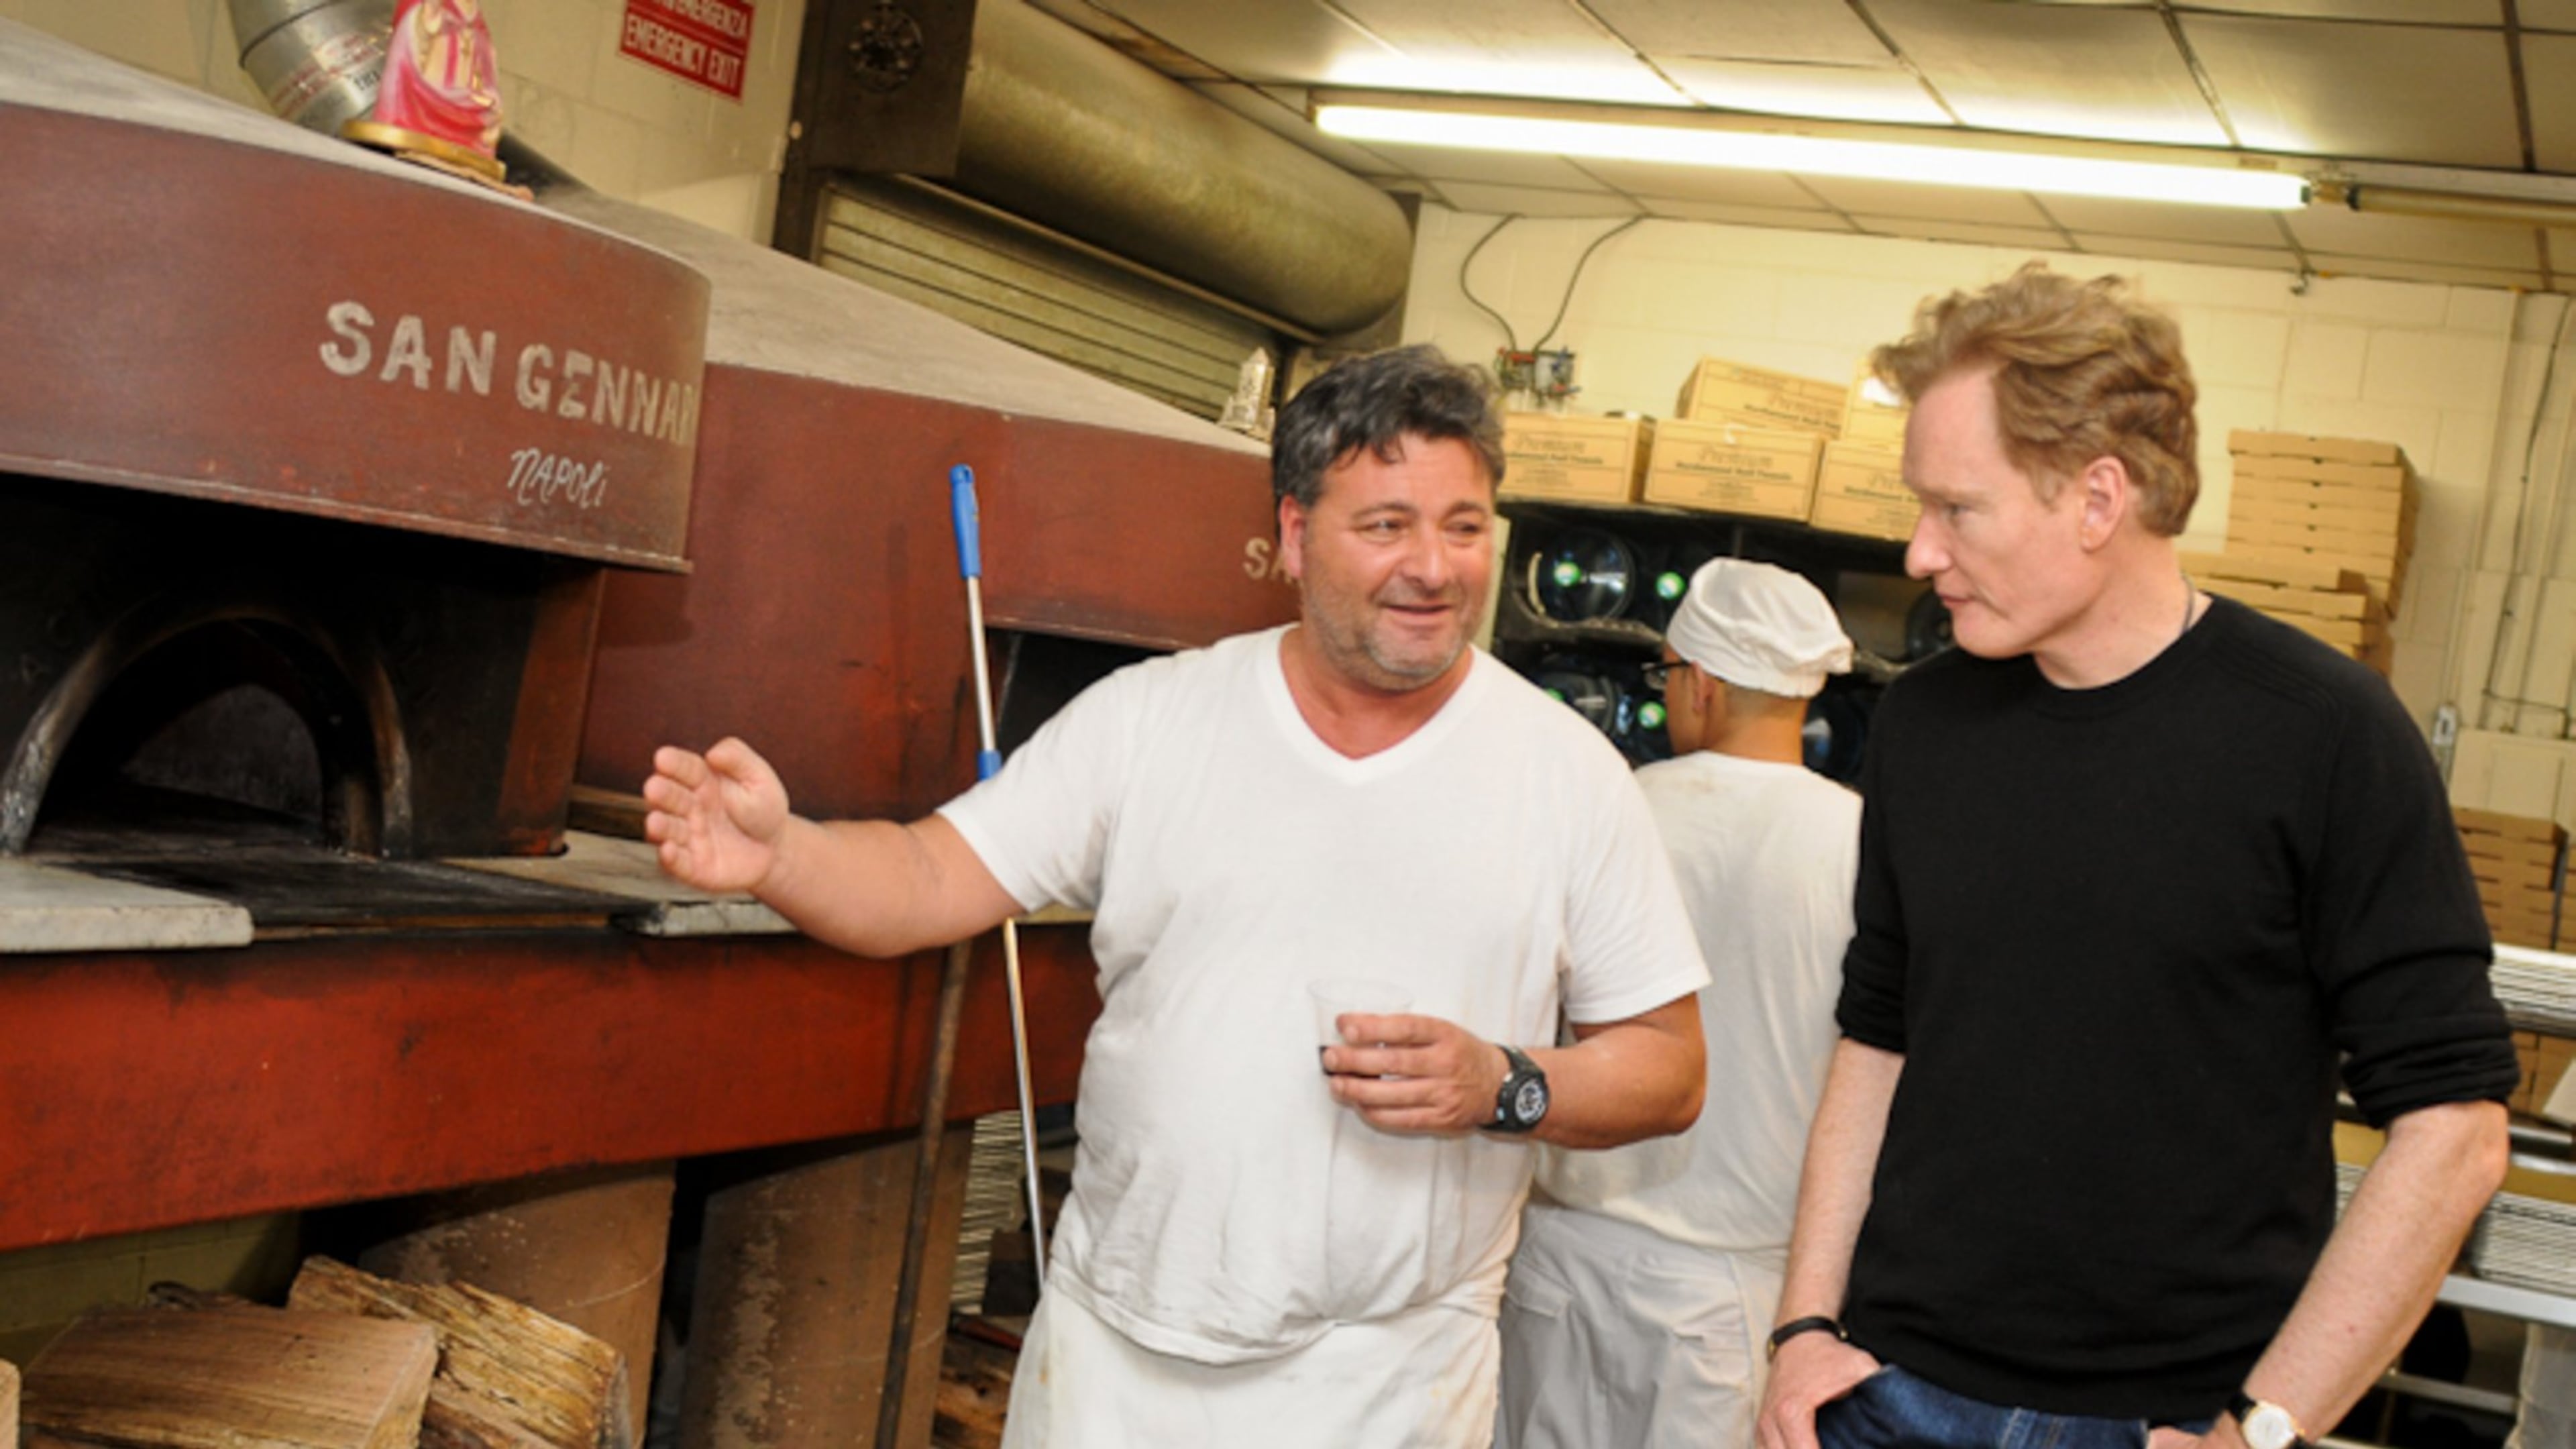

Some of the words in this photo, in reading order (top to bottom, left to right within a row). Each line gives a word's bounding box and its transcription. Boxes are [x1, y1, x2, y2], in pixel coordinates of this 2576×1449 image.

[625, 12, 707, 76] EMERGENCY
[706, 46, 741, 90] EXIT
[319, 299, 497, 397] SAN
